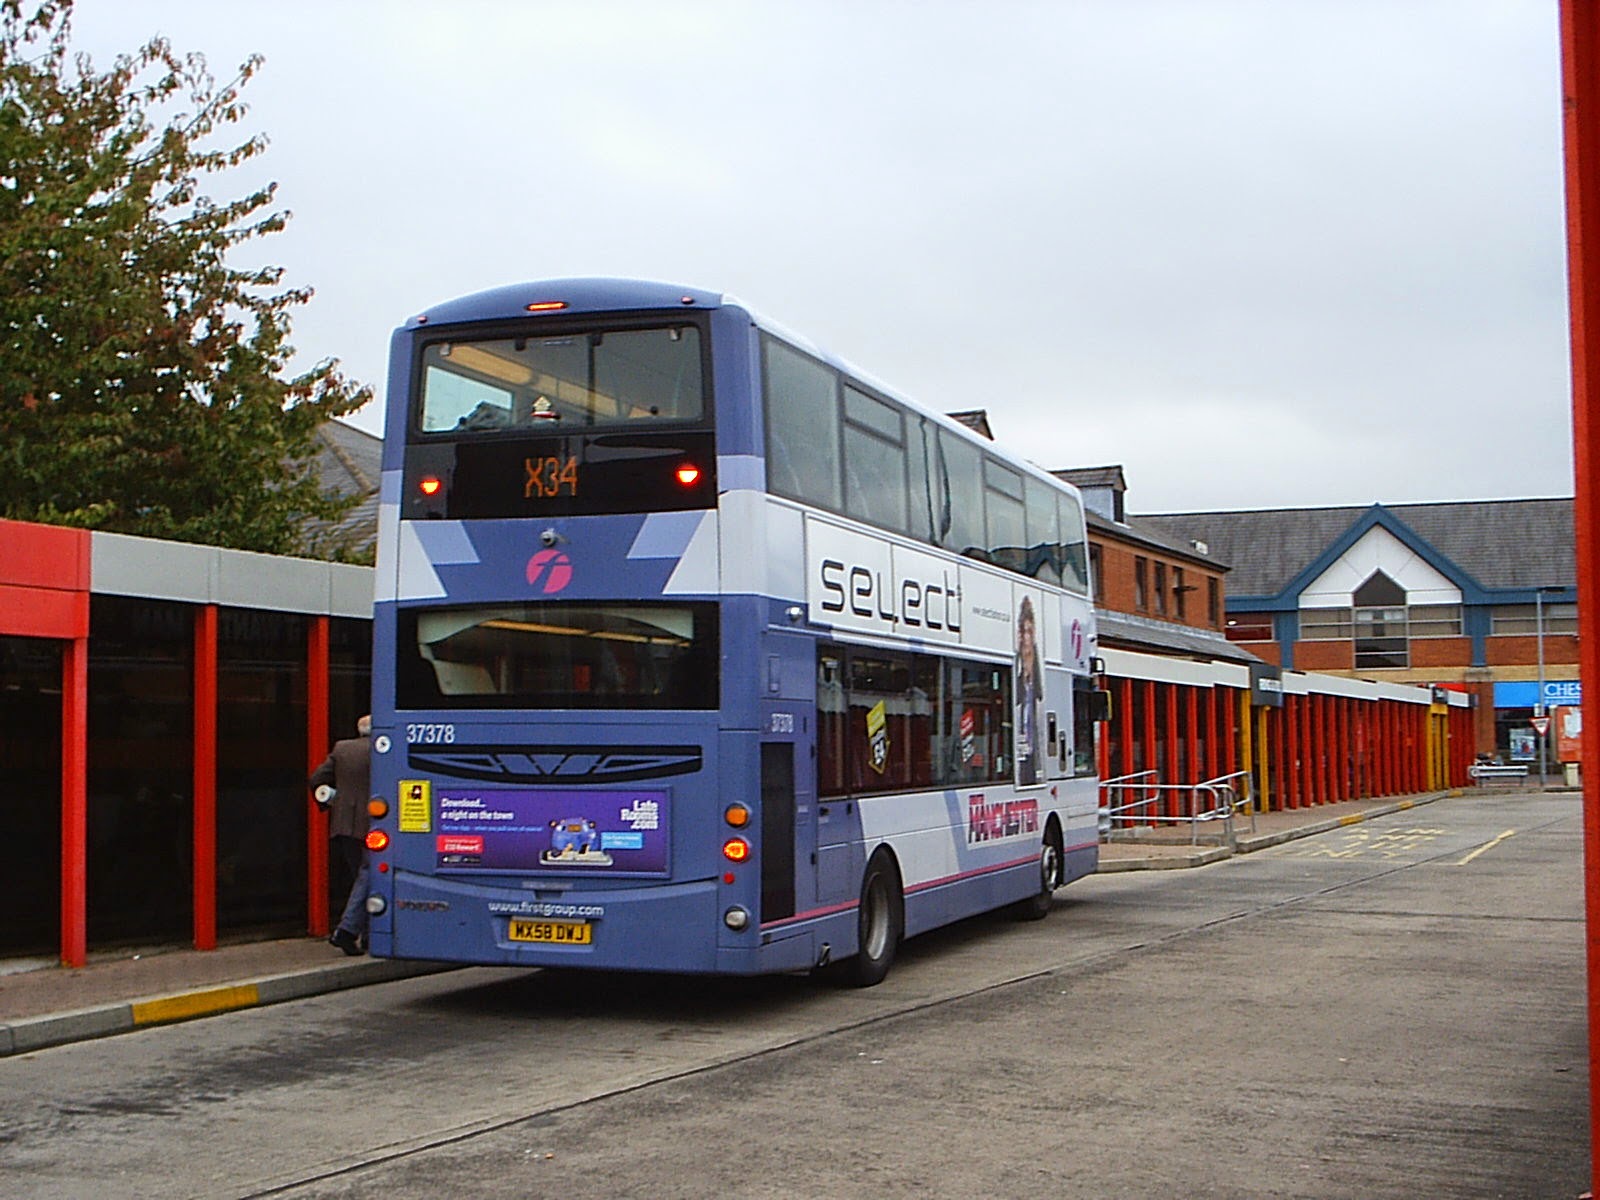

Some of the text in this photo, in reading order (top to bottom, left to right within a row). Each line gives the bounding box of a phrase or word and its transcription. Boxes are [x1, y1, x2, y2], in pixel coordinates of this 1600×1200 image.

[524, 456, 578, 498] X34
[405, 723, 456, 744] 37378
[633, 799, 659, 811] Late
[448, 809, 468, 822] night
[468, 812, 478, 820] on
[479, 809, 492, 820] the
[493, 811, 514, 820] town
[620, 809, 659, 821] Rooms
[630, 820, 658, 830] .com
[488, 900, 604, 917] www.firstgroup.com
[515, 922, 585, 942] MX58 DWJ
